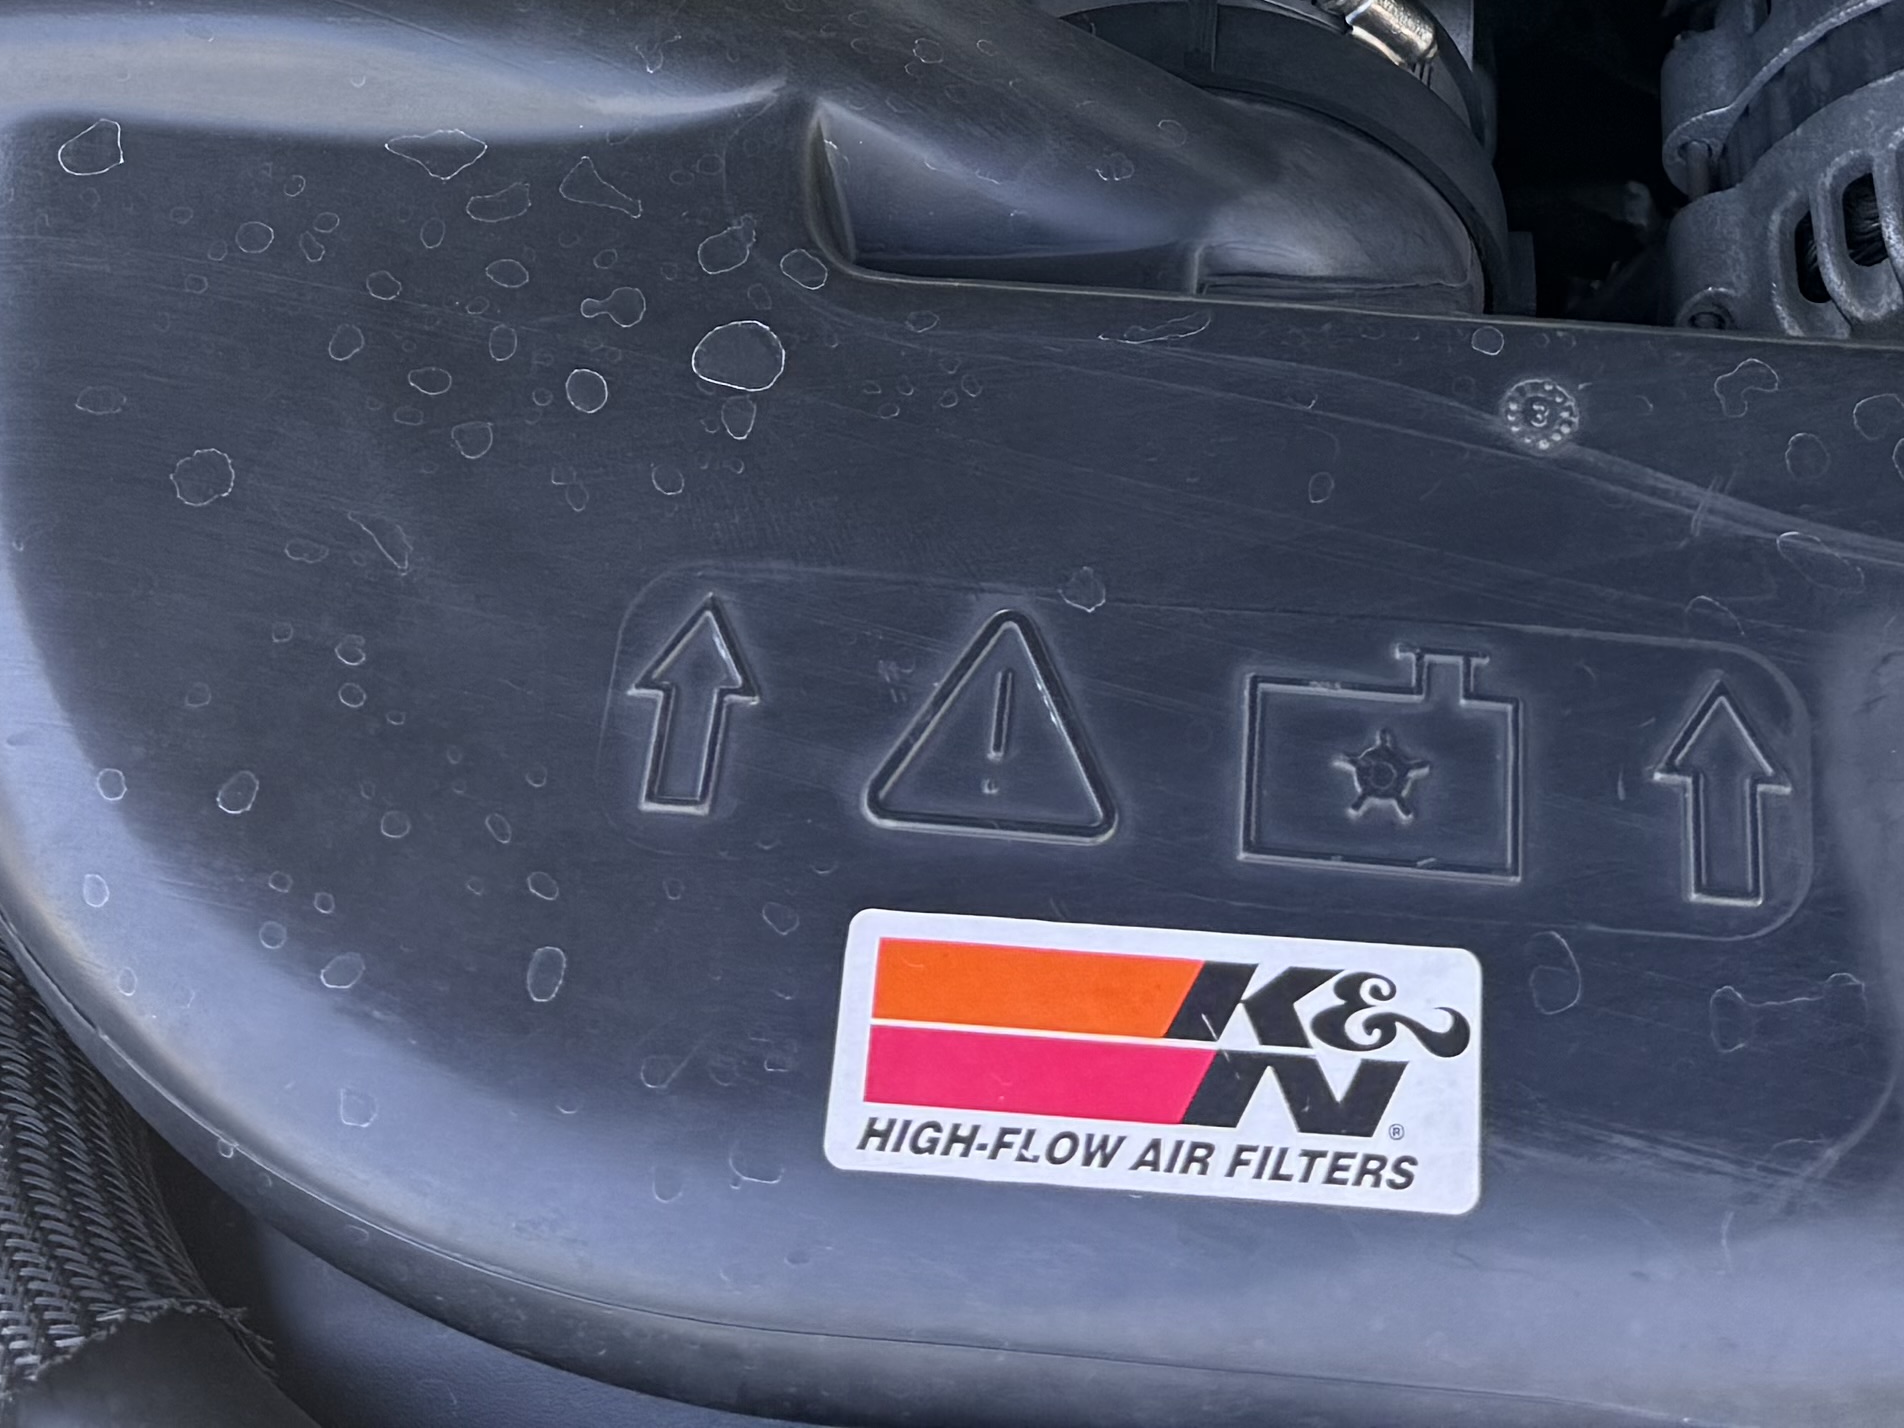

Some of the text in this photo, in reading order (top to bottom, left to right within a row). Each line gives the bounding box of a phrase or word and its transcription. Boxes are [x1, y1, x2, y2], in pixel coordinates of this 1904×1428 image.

[1163, 961, 1471, 1138] K&N
[857, 1116, 1419, 1193] HIGH-FLOW AIR FILTERS
